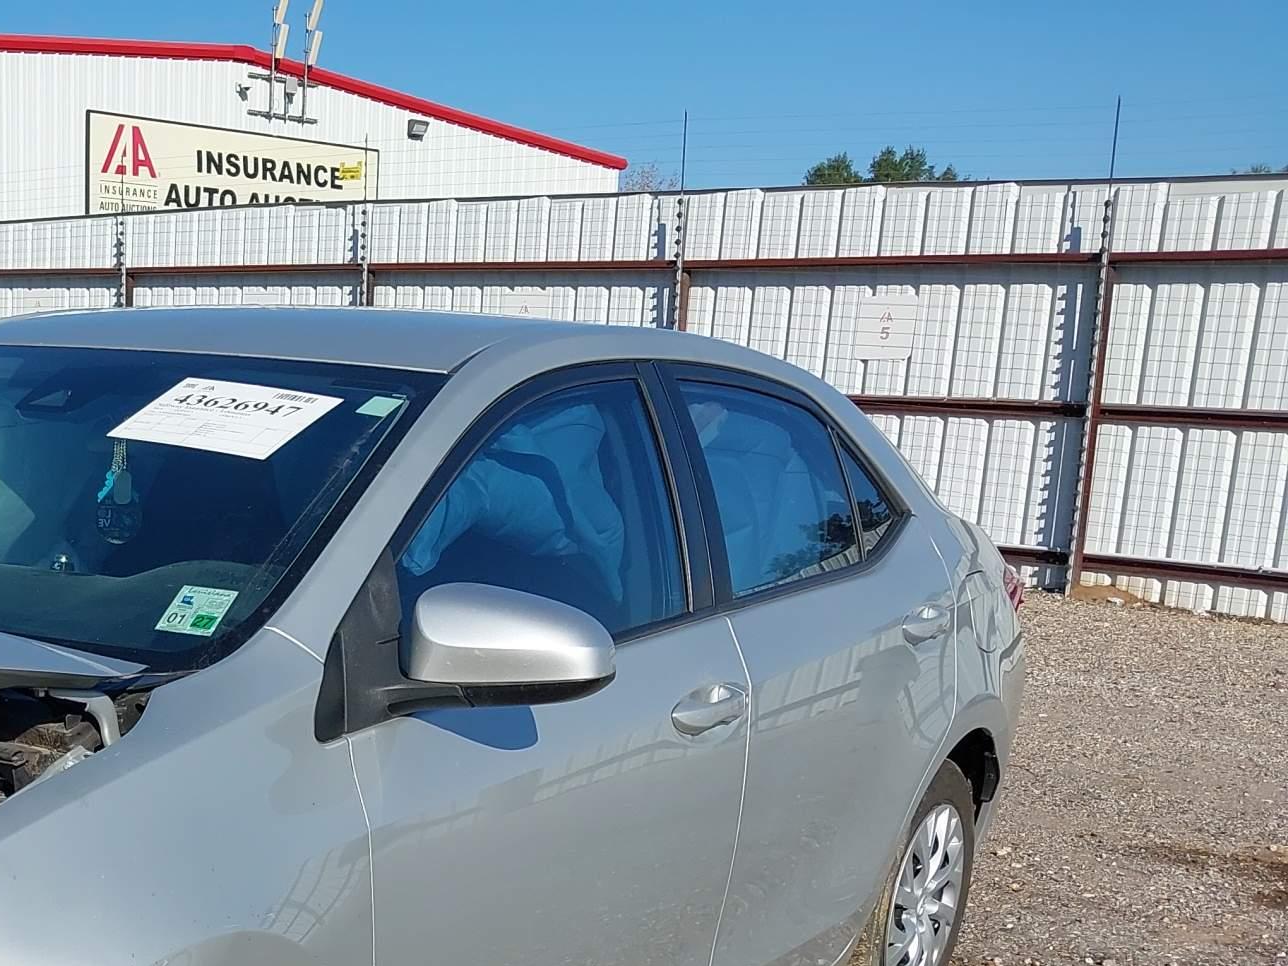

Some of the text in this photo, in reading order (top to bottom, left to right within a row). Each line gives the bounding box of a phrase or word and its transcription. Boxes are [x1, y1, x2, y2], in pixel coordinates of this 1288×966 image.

[196, 150, 344, 190] INSURANCE
[99, 184, 158, 199] INSURANCE
[164, 184, 238, 208] AUTO
[99, 201, 119, 212] AUTO
[880, 326, 891, 340] 5
[174, 393, 304, 417] 43626947
[167, 612, 186, 625] 01
[192, 615, 214, 628] 27
